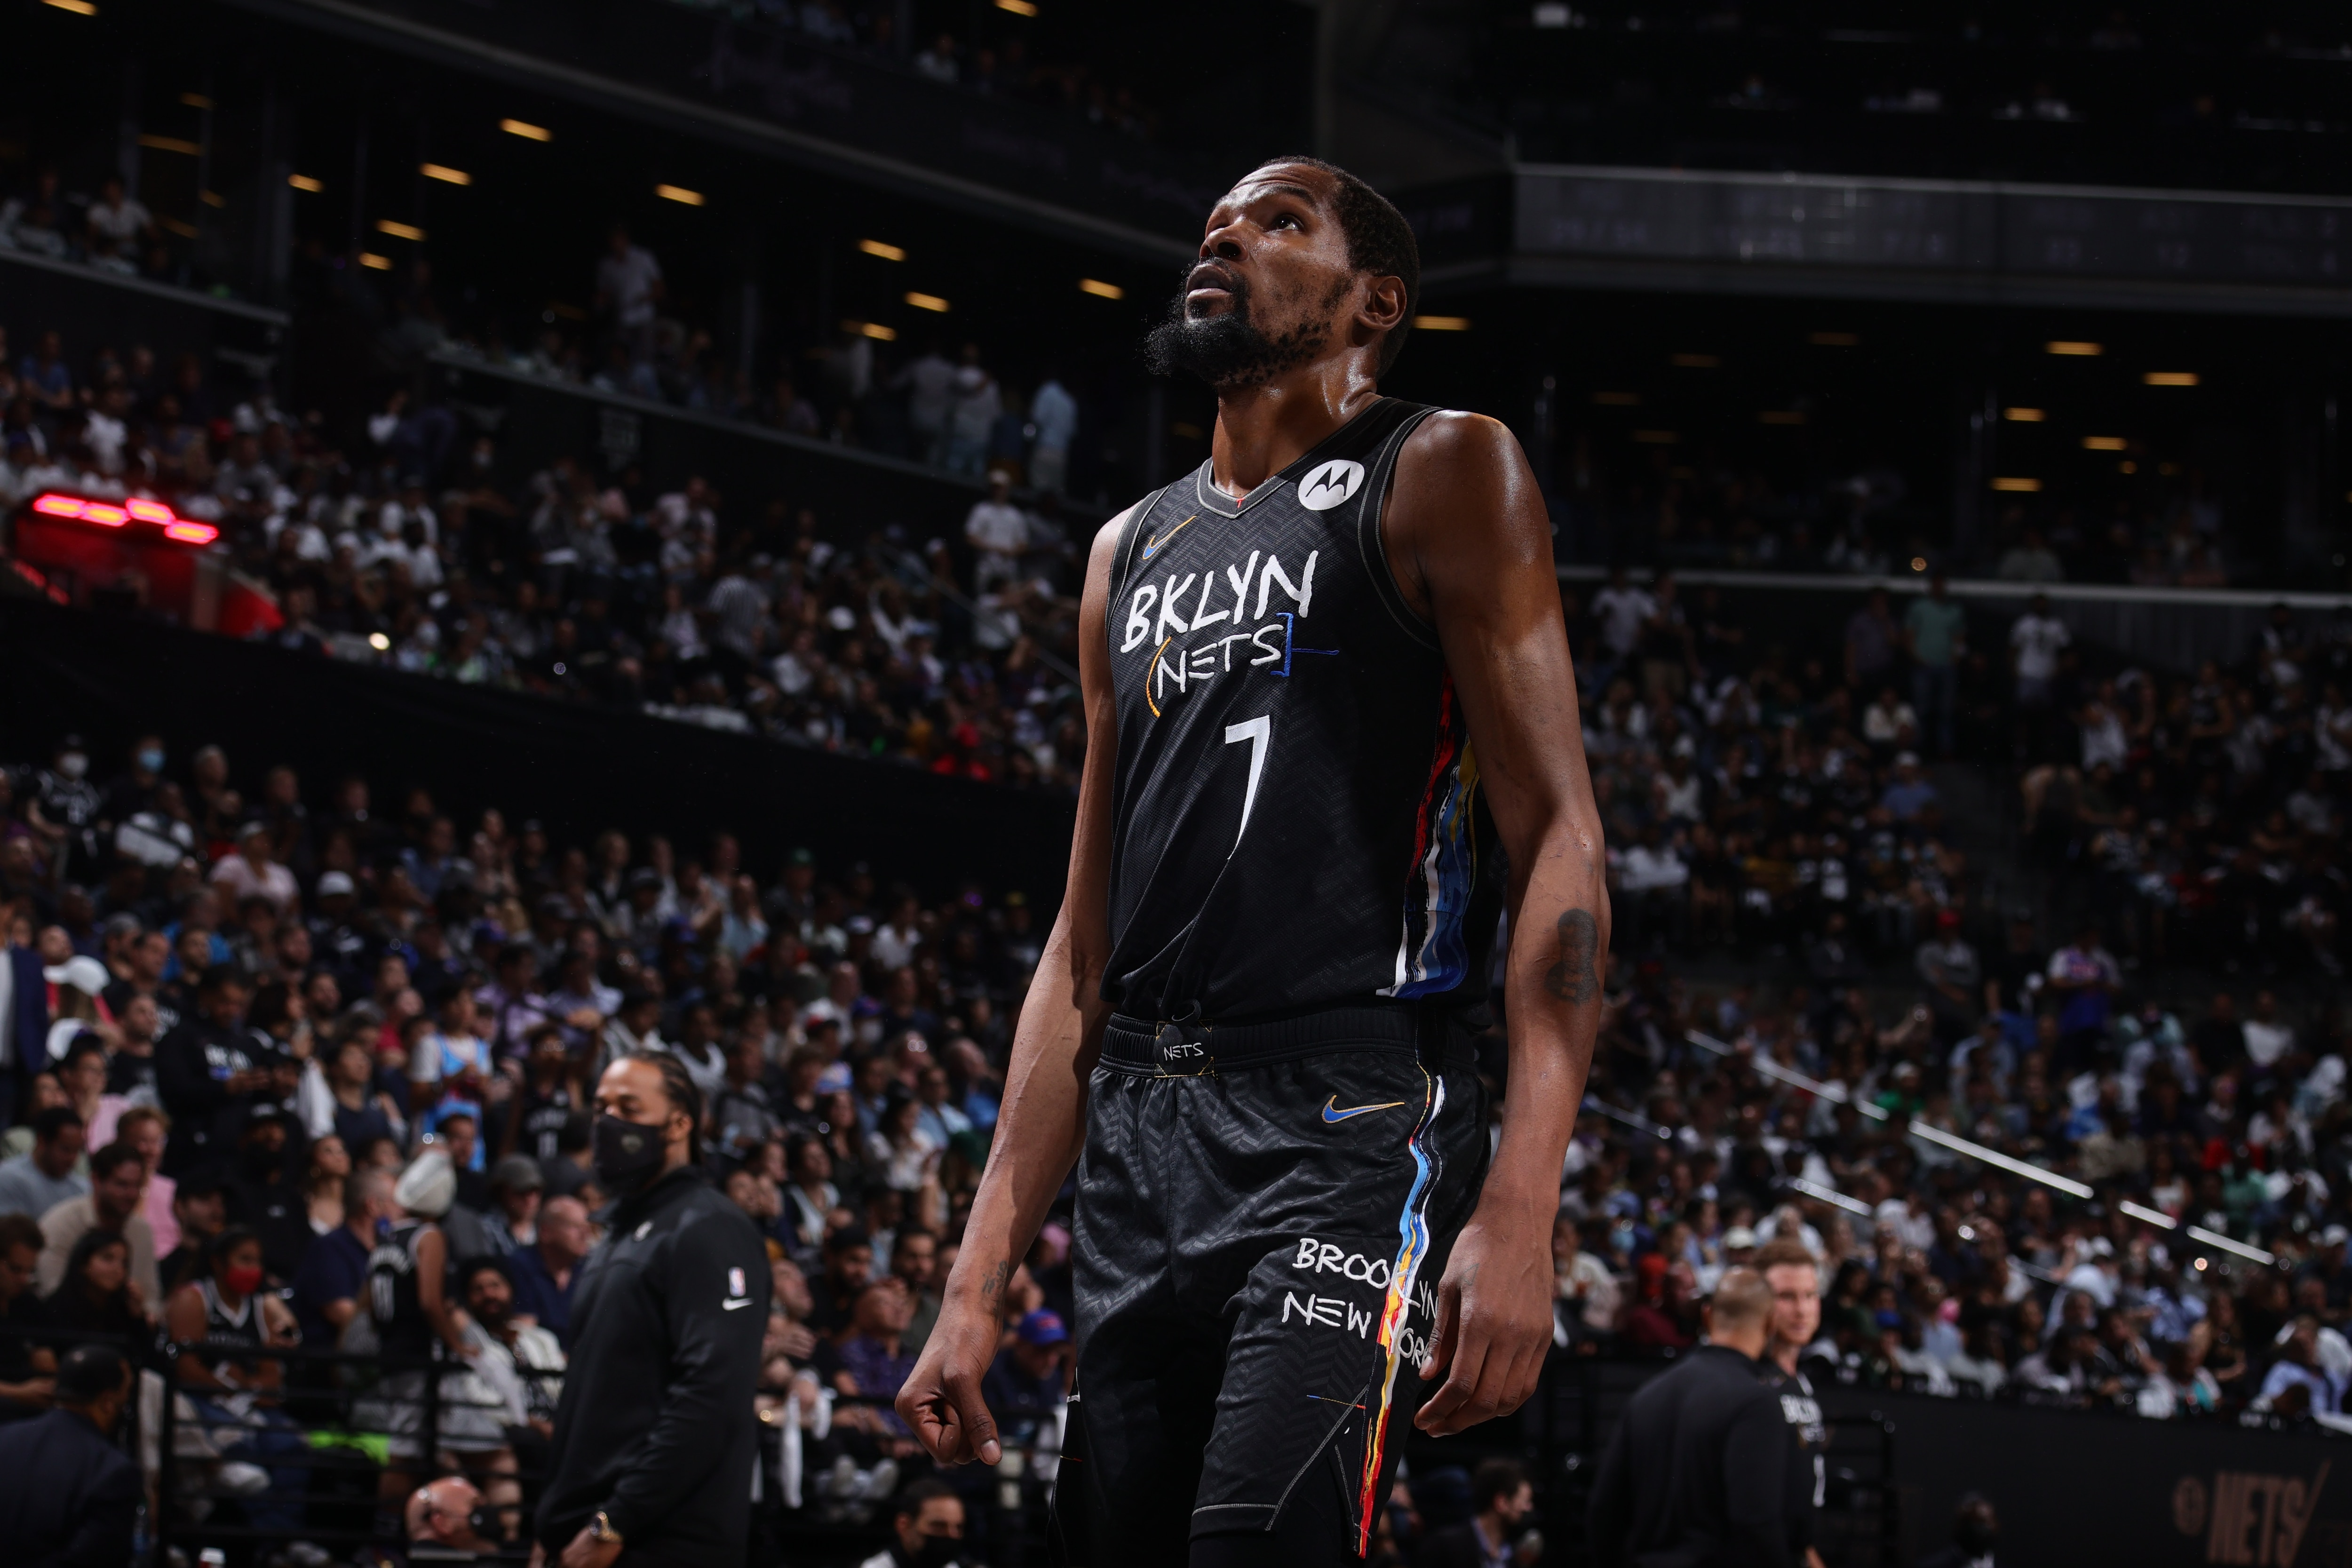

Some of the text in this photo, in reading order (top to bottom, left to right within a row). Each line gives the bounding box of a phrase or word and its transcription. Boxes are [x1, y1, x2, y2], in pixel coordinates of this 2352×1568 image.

[1120, 550, 1319, 653] BKLYN
[1225, 715, 1270, 860] 7
[1164, 1042, 1204, 1061] NETS
[1281, 1291, 1430, 1369] NEW YOR
